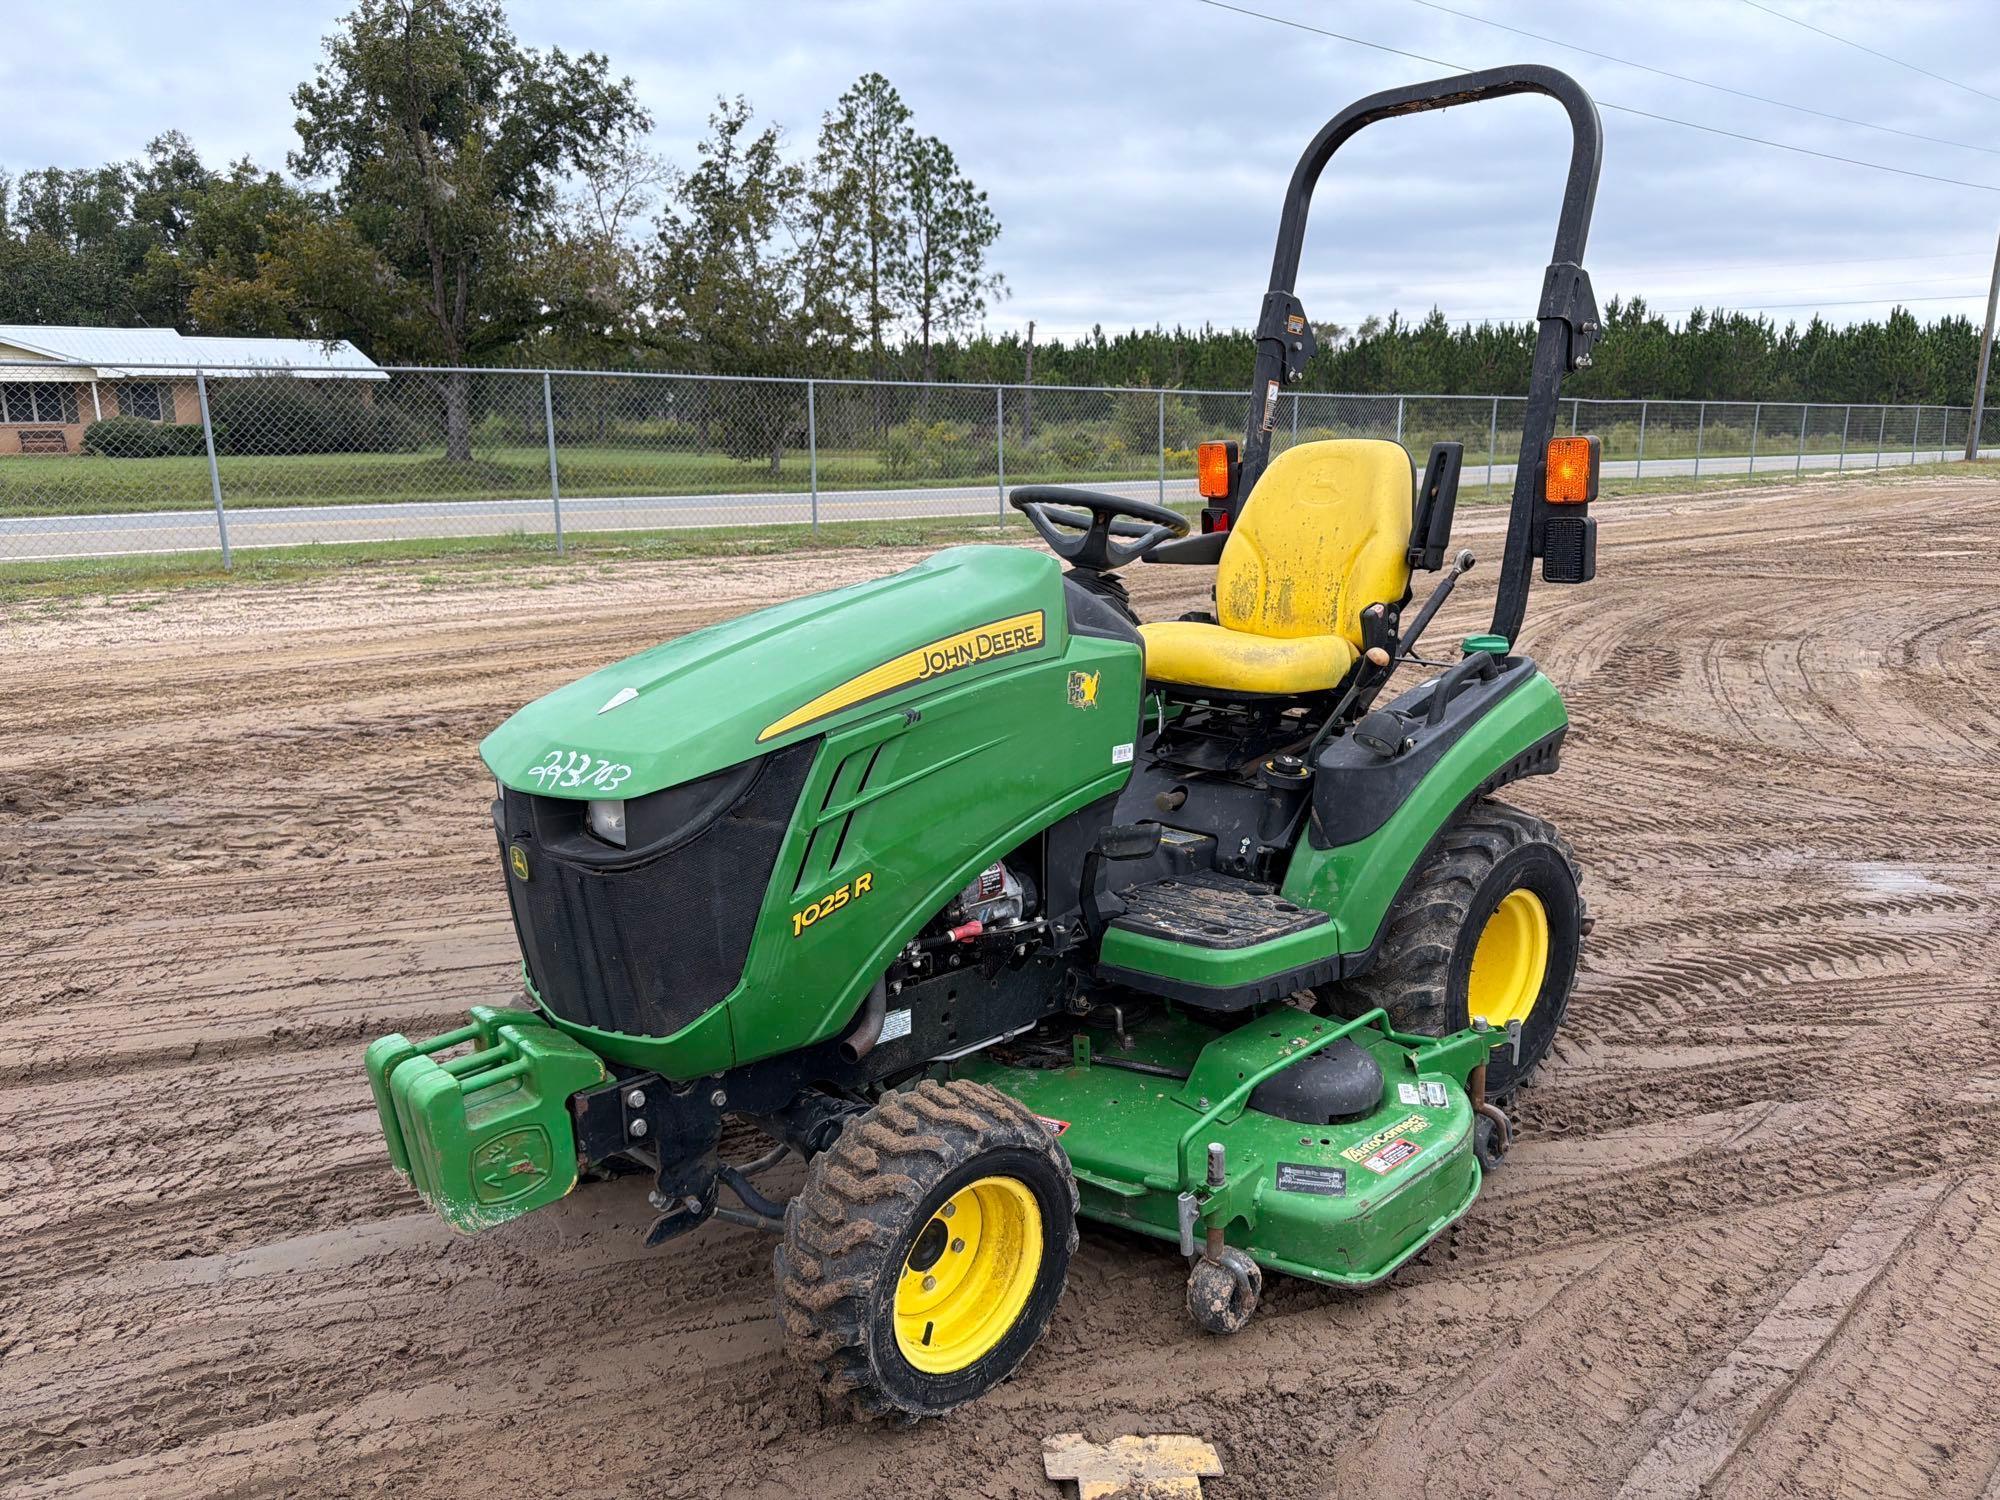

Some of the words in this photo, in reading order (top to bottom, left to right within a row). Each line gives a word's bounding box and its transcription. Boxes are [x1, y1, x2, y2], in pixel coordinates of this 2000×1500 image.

[919, 642, 974, 676] JOHN
[976, 625, 1037, 658] DEERE
[1069, 687, 1085, 702] Pro
[1347, 1113, 1425, 1160] AutoConnect
